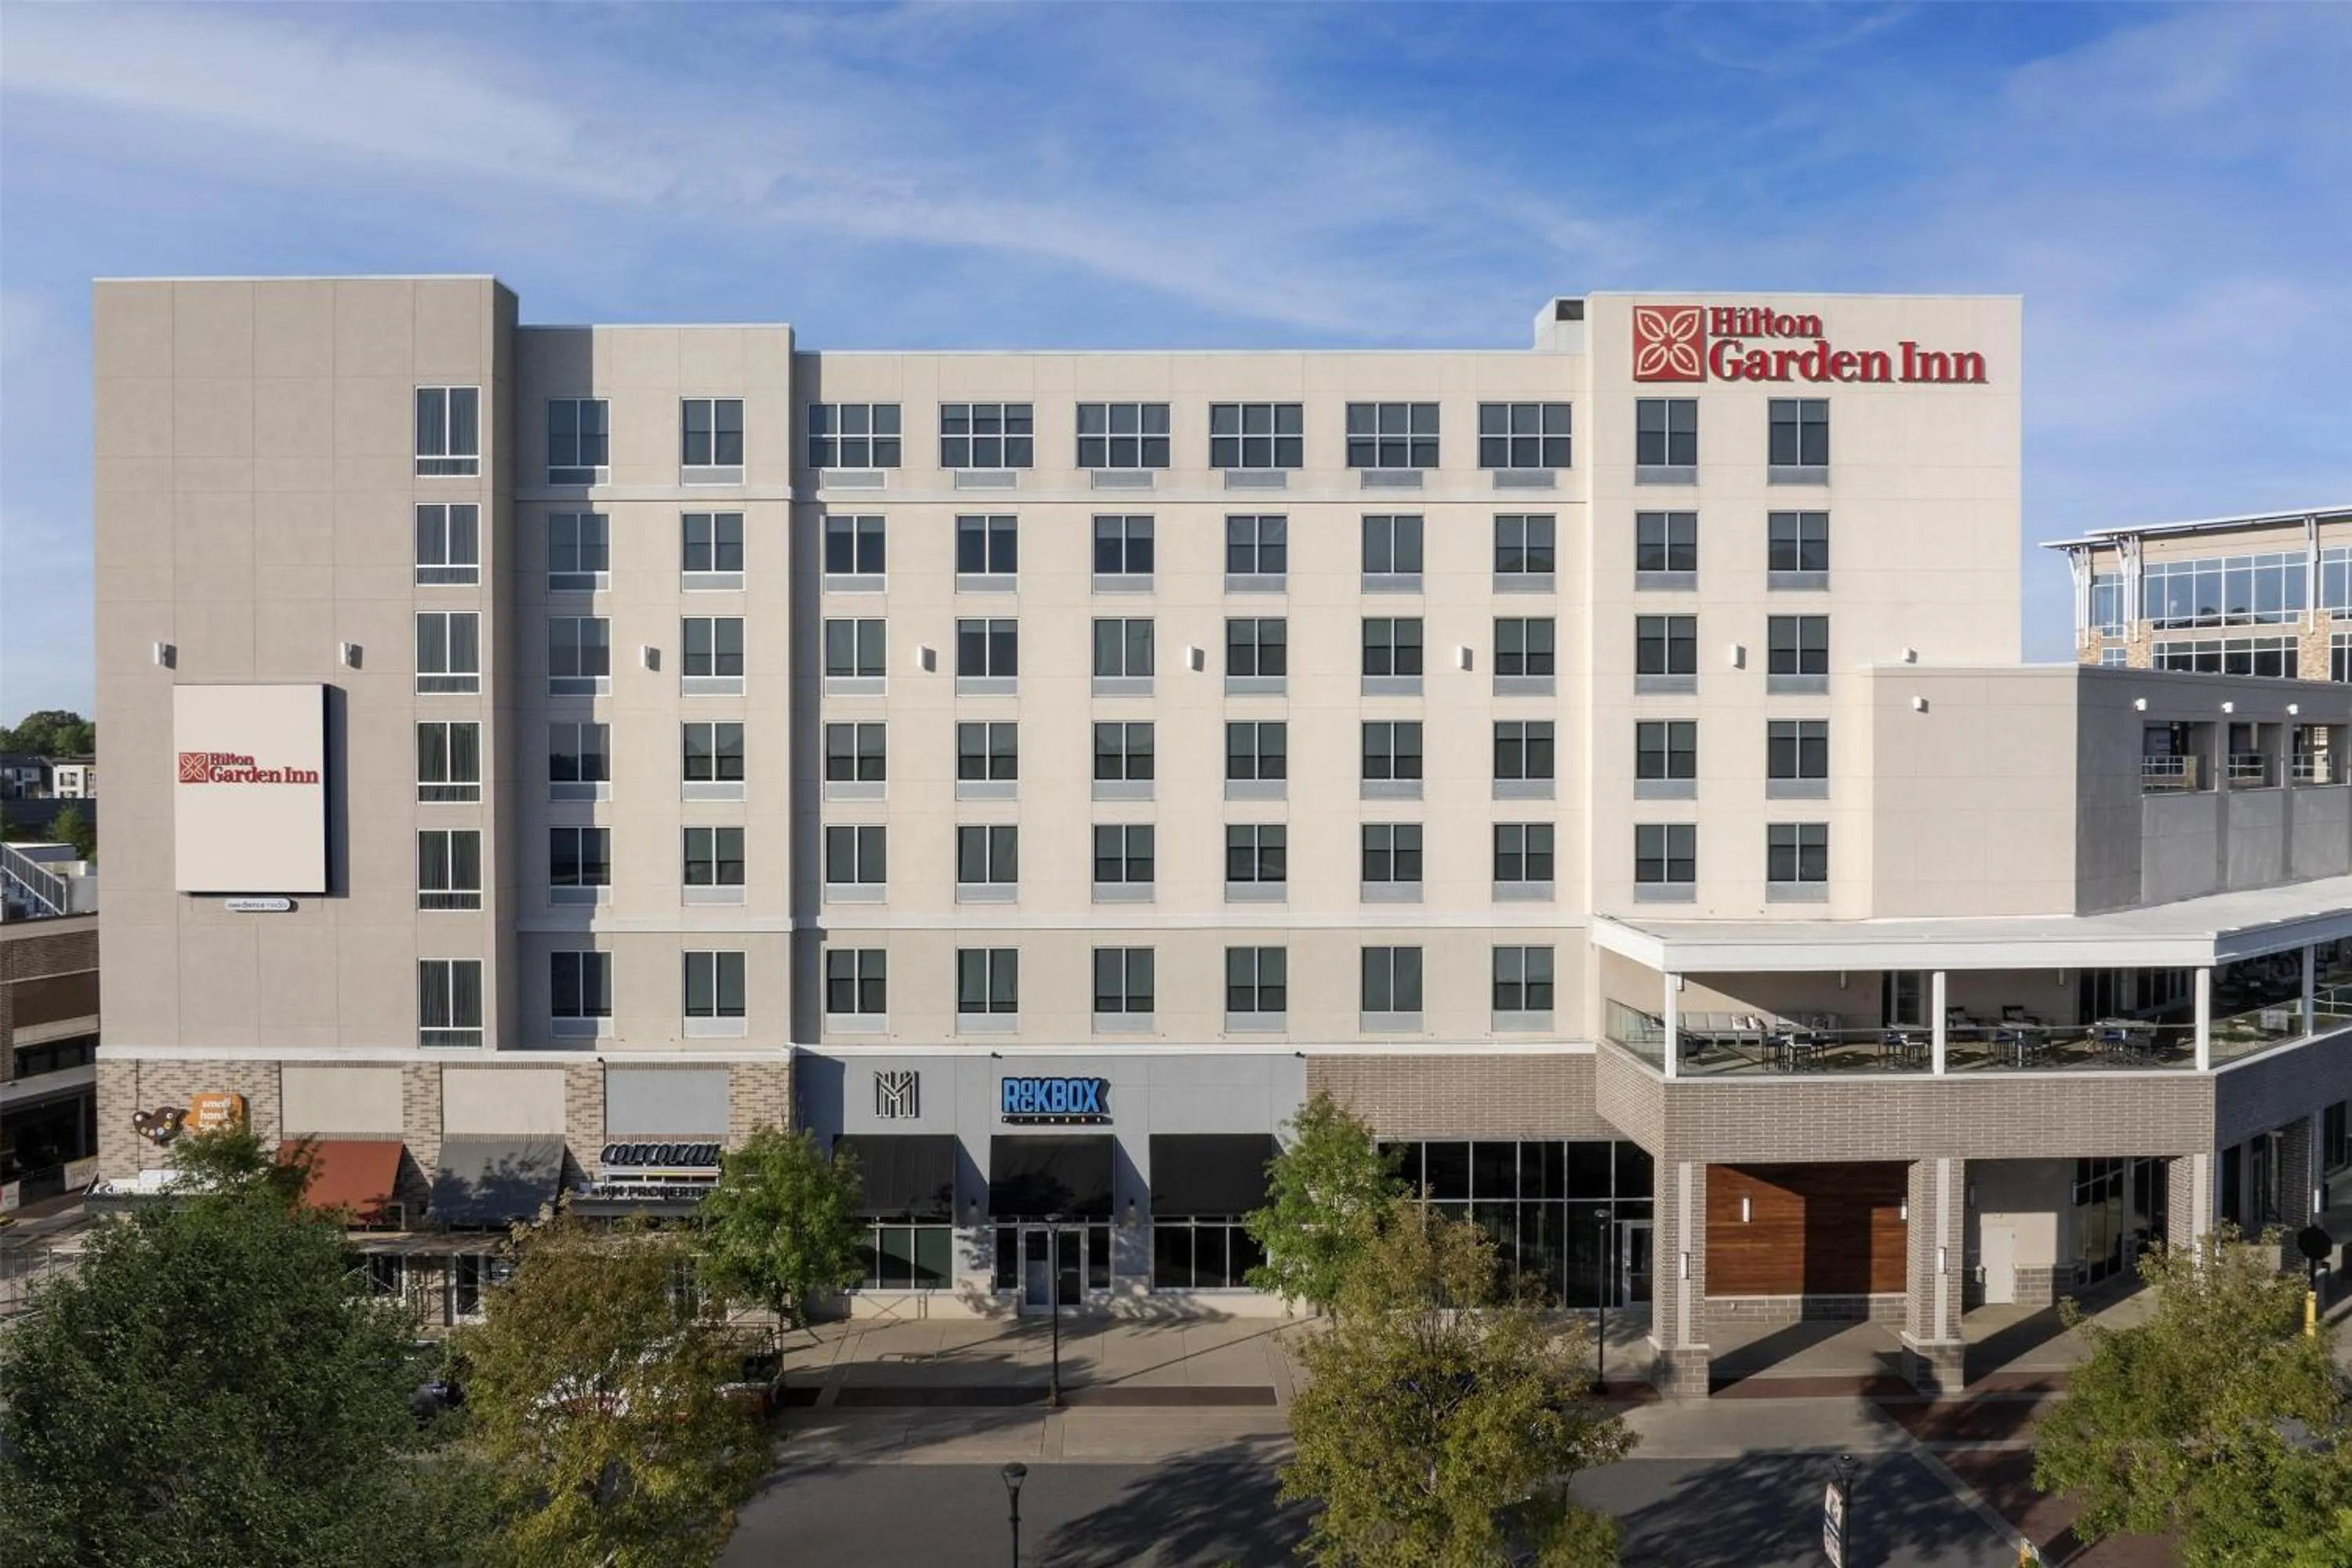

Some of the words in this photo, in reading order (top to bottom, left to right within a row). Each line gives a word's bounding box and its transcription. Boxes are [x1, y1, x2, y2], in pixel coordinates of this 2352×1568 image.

[1708, 306, 1823, 338] Hilton
[1708, 339, 1896, 383] Garden
[1898, 341, 1989, 383] Inn
[209, 753, 255, 766] Hilton
[209, 766, 281, 783] Garden
[284, 767, 319, 783] Inn
